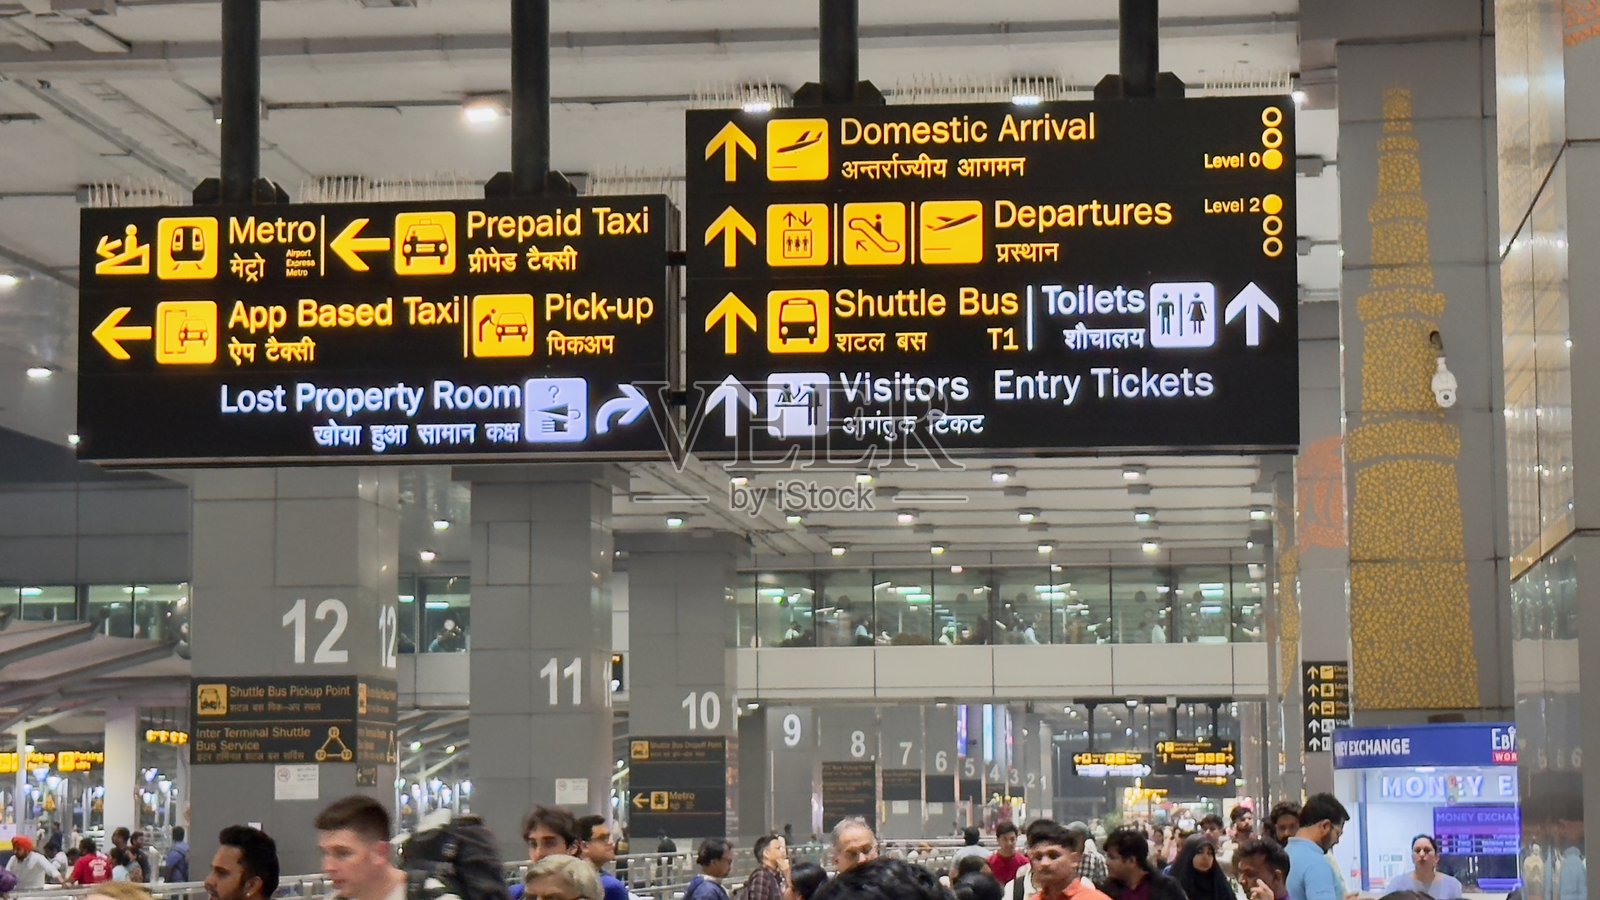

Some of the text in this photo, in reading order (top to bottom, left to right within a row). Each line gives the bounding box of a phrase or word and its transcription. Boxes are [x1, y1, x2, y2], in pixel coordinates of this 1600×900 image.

[841, 112, 1096, 145] Domestic Arrival
[841, 153, 1027, 180] अन्तर्राज्यीय आगमन
[1204, 152, 1261, 169] Level 0
[995, 199, 1173, 233] Departures
[1204, 198, 1261, 213] Level 2
[229, 216, 316, 244] Metro
[467, 206, 649, 243] Prepaid Taxi
[286, 249, 312, 258] Airport
[286, 259, 316, 268] Express
[468, 245, 578, 273] प्रीपेड टैक्सी
[996, 242, 1060, 263] प्रस्थान
[230, 252, 266, 282] मेट्रो
[286, 269, 309, 277] Metro
[545, 292, 654, 325] Pick-up
[834, 286, 1019, 318] Shuttle Bus
[1041, 283, 1146, 316] Toilets
[228, 295, 460, 333] App Based Taxi
[546, 330, 615, 356] पिकअप
[835, 331, 928, 352] शटल बस
[987, 327, 1019, 350] T1
[1062, 321, 1146, 350] शौचालय
[228, 335, 316, 366] ऐप टैक्सी
[220, 379, 521, 417] Lost Property Room
[839, 367, 1214, 406] Visitors Entry Tickets
[313, 418, 520, 452] खोया हुआ सामान कक्ष
[842, 410, 985, 442] आगंतुक टिकट
[282, 598, 348, 663] 12
[378, 604, 397, 668] 12
[230, 685, 351, 698] Shuttle Bus Pickup Point
[540, 657, 582, 705] 11
[682, 691, 721, 729] 10
[196, 728, 221, 739] Inter
[224, 727, 269, 738] Terminal
[272, 727, 311, 738] Shuttle
[783, 713, 801, 746] 9
[196, 741, 260, 751] Bus Service
[851, 730, 866, 757] 8
[900, 742, 912, 765] 7
[1349, 738, 1410, 756] EXCHANGE
[935, 751, 947, 771] 6
[965, 758, 975, 776] 5
[989, 764, 1000, 781] 4
[1010, 769, 1019, 784] 3
[1027, 773, 1035, 787] 2
[1040, 775, 1046, 790] 1
[670, 791, 695, 800] Metro
[1436, 813, 1474, 821] MONEY
